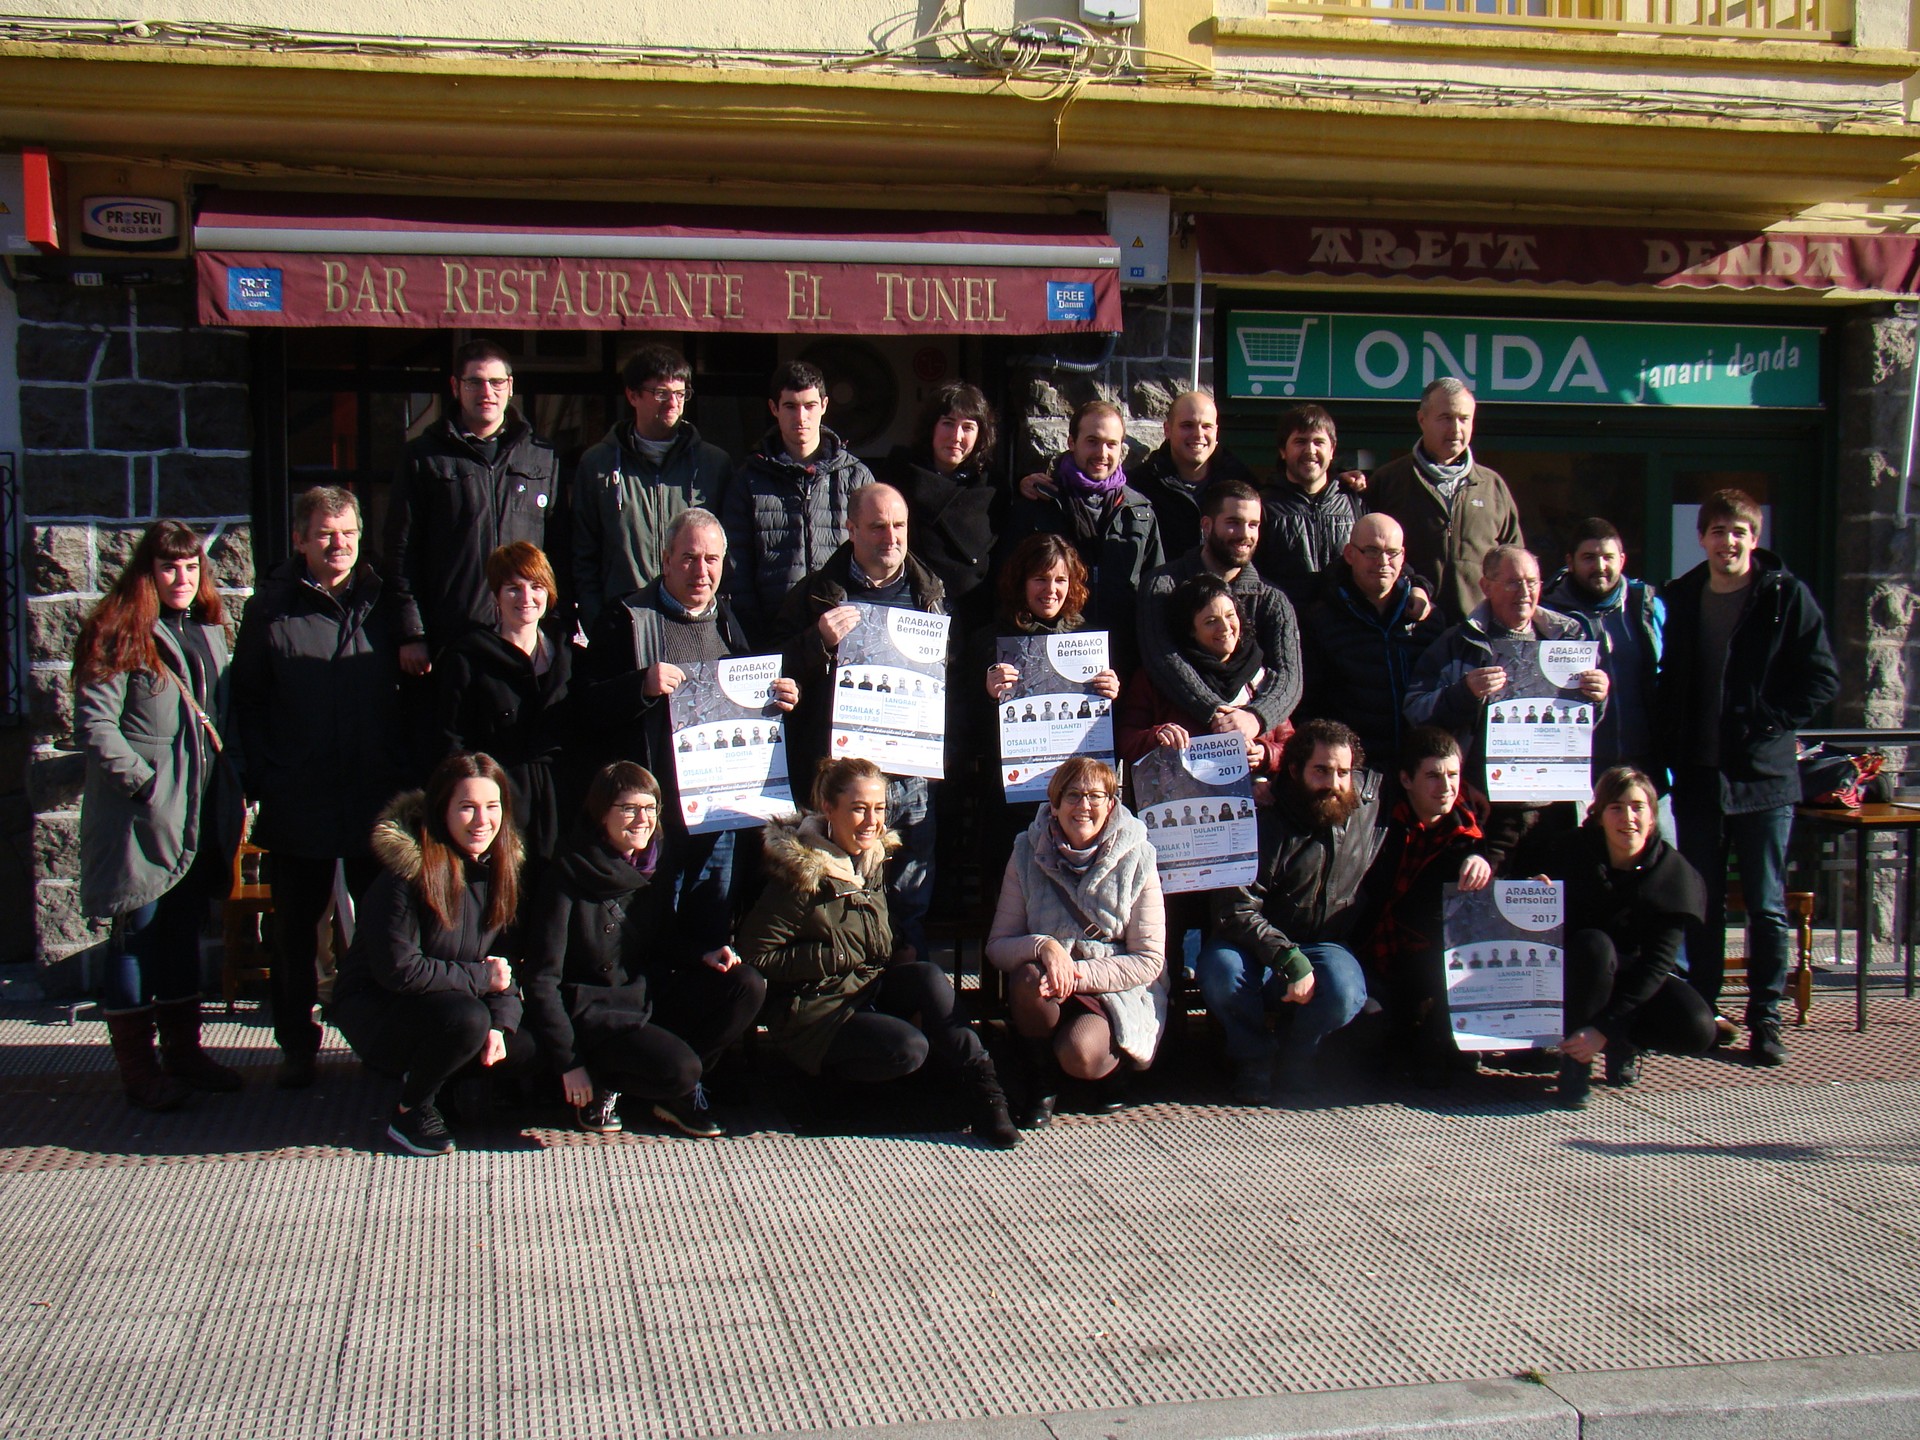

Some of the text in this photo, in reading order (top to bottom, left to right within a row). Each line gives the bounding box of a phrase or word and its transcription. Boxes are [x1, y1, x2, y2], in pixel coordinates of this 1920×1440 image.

[1308, 227, 1846, 278] ARETA DENDA
[322, 260, 1007, 322] BAR RESTAURANTE EL TUNEL
[1056, 290, 1085, 301] FREE
[1058, 300, 1084, 309] Damm
[1354, 330, 1608, 393] ONDA
[1636, 336, 1800, 404] janari denda
[898, 616, 944, 630] ARABAKO
[897, 624, 942, 638] Bertsolari
[1058, 638, 1102, 648] ARABAKO
[919, 646, 940, 656] 2017
[1058, 646, 1103, 657] Bertsolari
[1548, 655, 1591, 663] Bertsolari
[729, 662, 776, 673] ARABAKO
[1082, 665, 1104, 674] 2017
[728, 670, 776, 682] Bertsolari
[840, 705, 874, 715] OTSAILAK
[1007, 738, 1038, 746] OTSAILAK
[1189, 738, 1238, 752] ARABAKO
[1190, 748, 1240, 761] Bertsolari
[1218, 765, 1242, 776] 2017
[1193, 826, 1225, 834] DULANTZI
[1506, 887, 1556, 896] ARABAKO
[1506, 896, 1557, 905] Bertsolari
[1532, 914, 1557, 923] 2017
